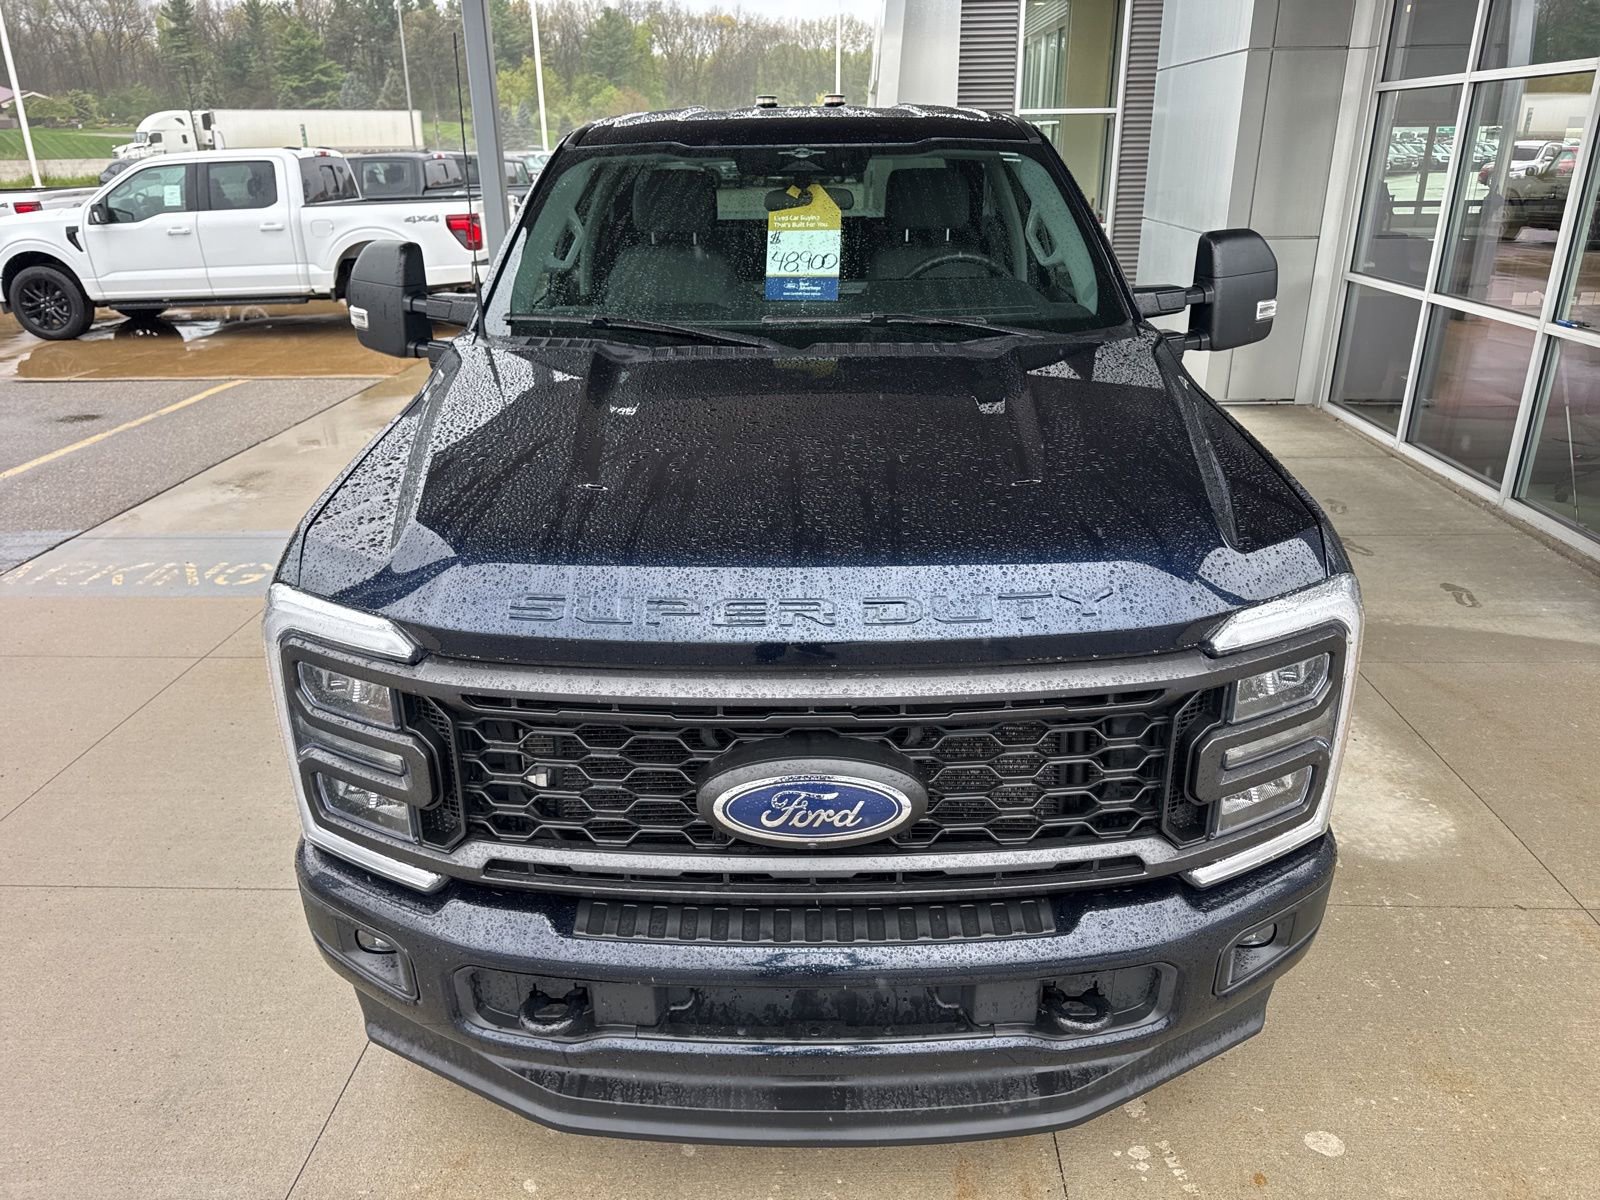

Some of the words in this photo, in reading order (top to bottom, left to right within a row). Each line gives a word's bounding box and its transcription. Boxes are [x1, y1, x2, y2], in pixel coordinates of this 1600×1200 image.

[508, 593, 836, 627] SUPER
[861, 586, 1114, 626] DUTY
[760, 789, 865, 829] Ford
